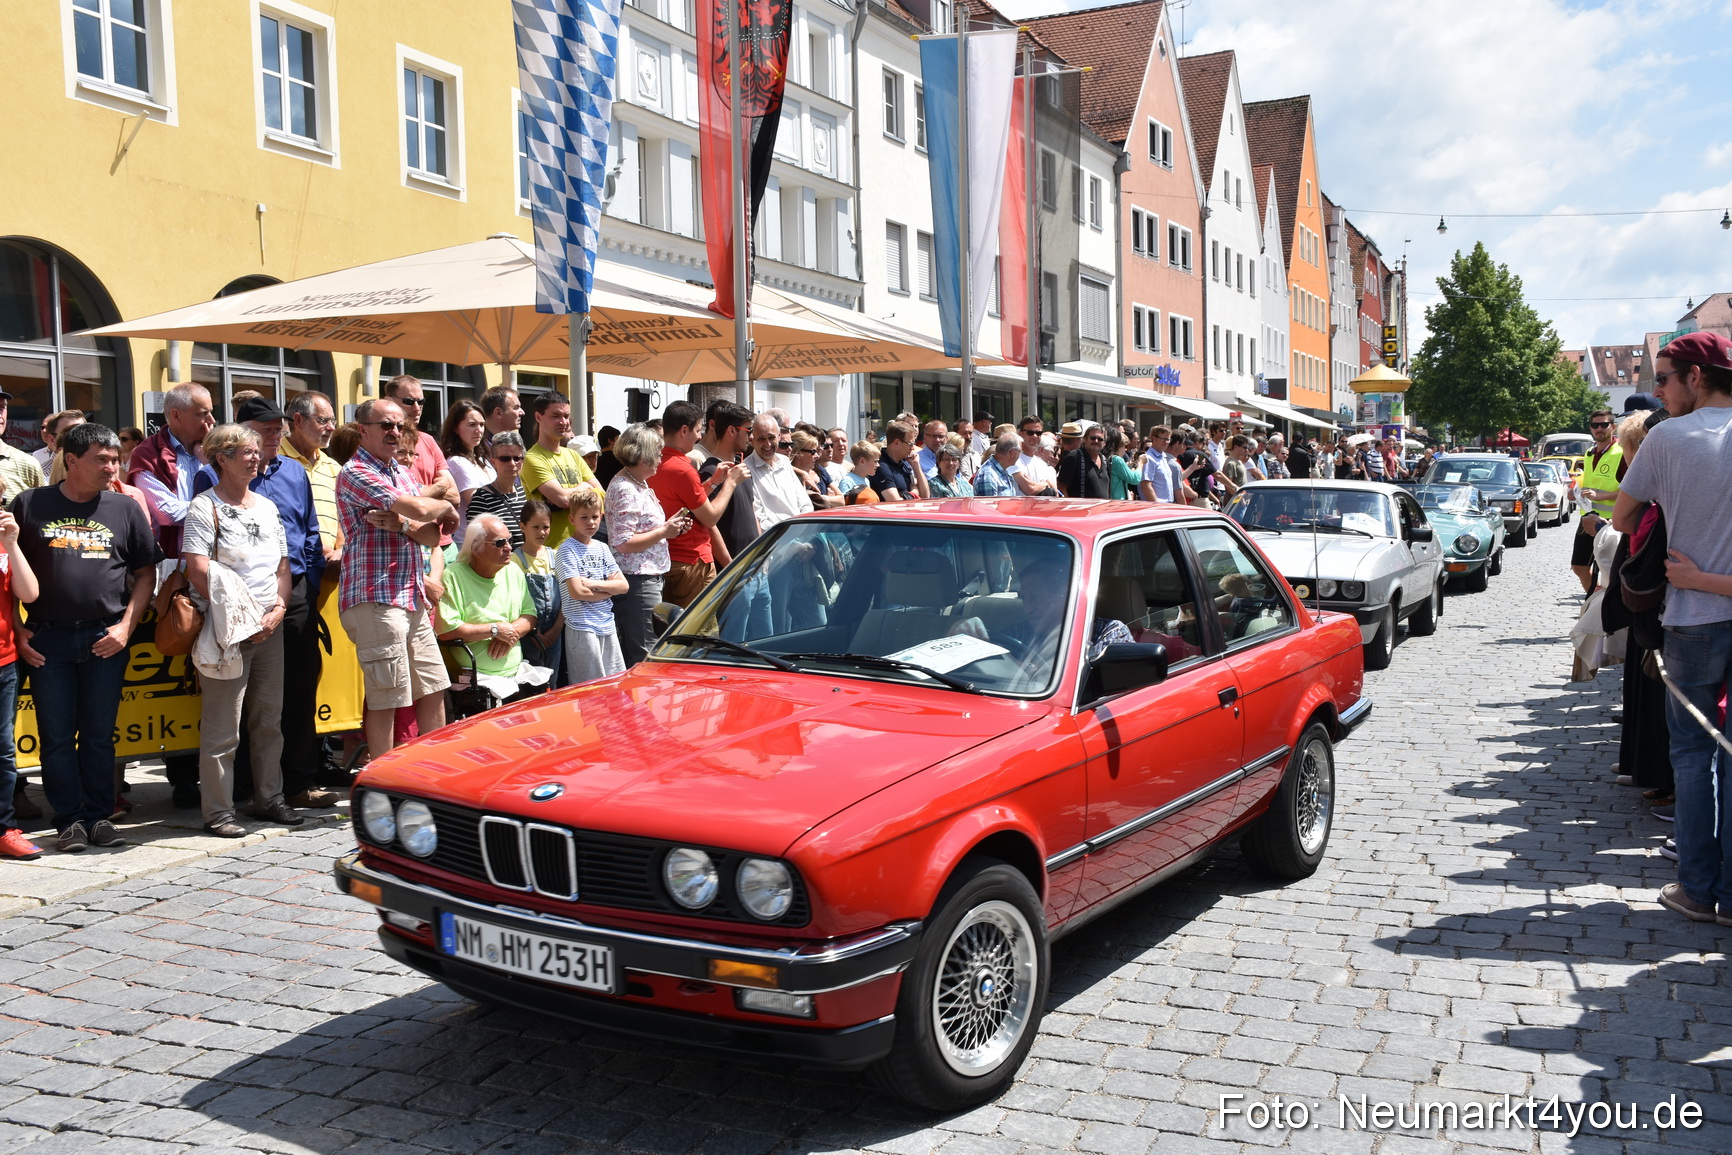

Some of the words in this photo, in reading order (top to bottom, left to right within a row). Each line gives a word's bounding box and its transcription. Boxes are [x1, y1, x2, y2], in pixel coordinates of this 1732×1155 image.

[930, 641, 963, 652] 583
[455, 919, 483, 959] NM
[500, 931, 534, 971] HM
[538, 940, 610, 986] 253H
